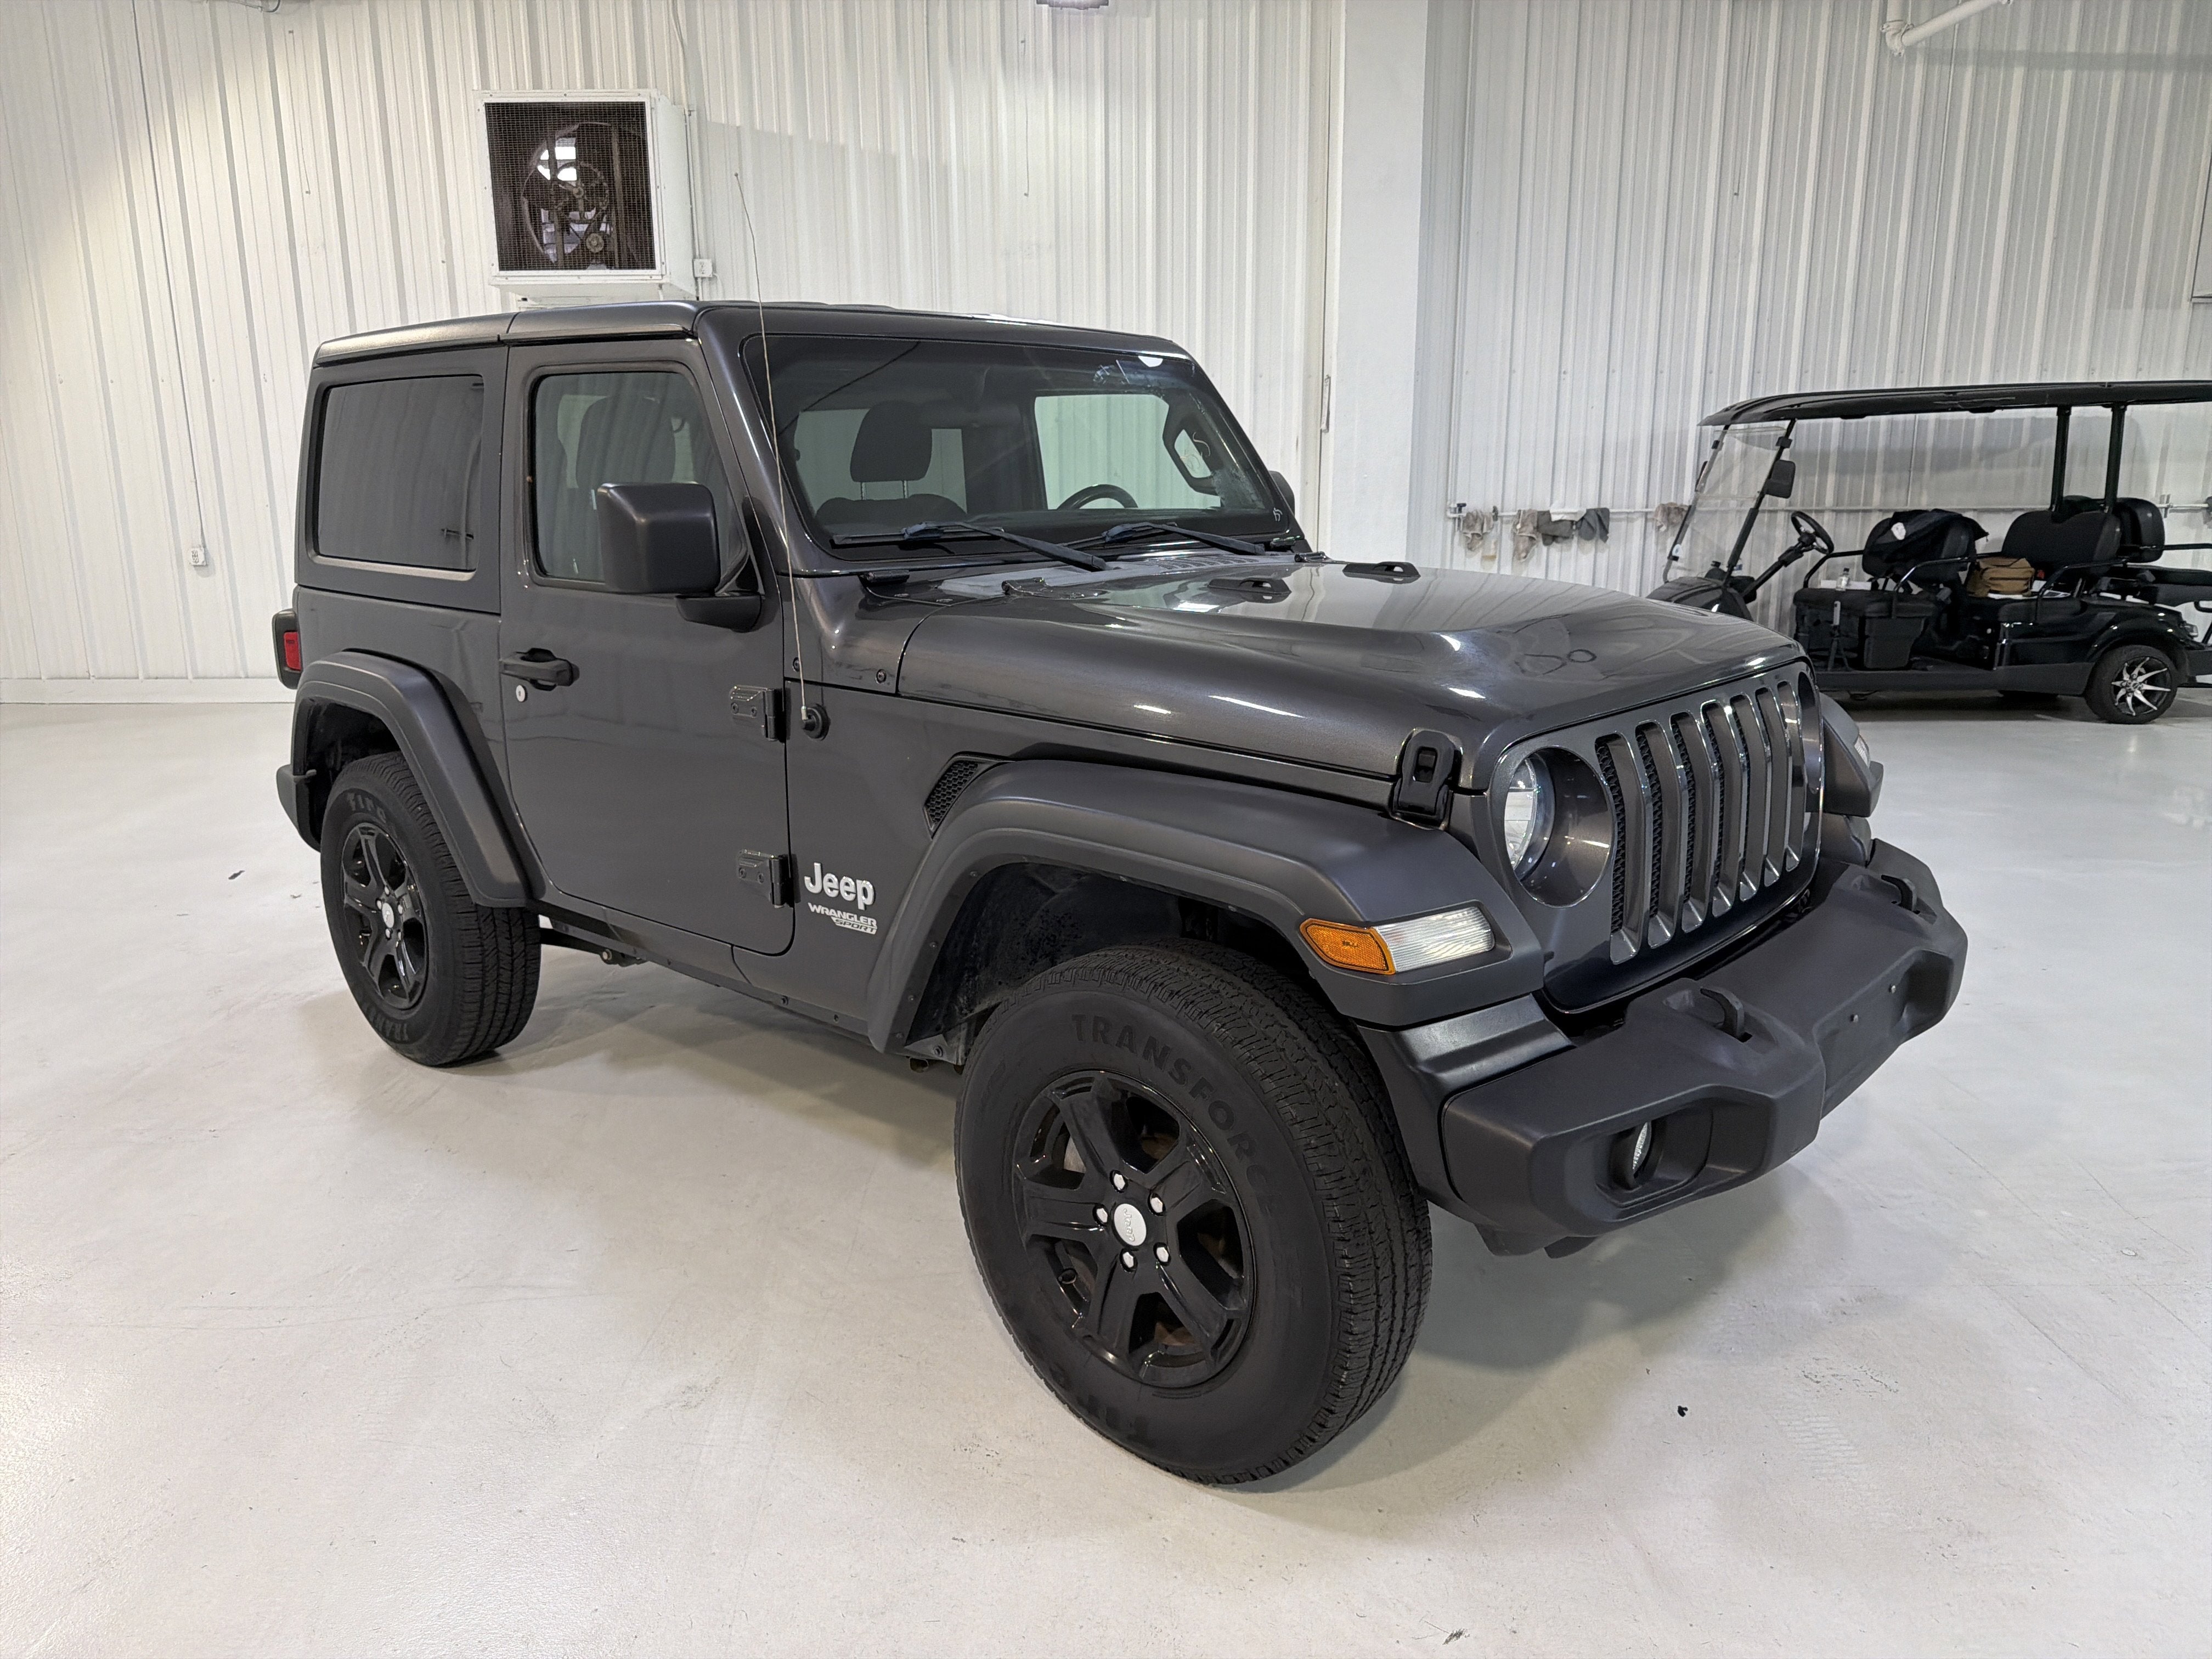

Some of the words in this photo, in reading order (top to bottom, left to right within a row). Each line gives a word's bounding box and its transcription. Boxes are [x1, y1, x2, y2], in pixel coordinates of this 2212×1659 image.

[804, 862, 874, 911] Jeep
[808, 902, 877, 927] WRANGLER
[833, 918, 876, 934] SPORT
[1071, 1013, 1279, 1211] TRANSFORC
[1122, 1207, 1136, 1243] Jeep
